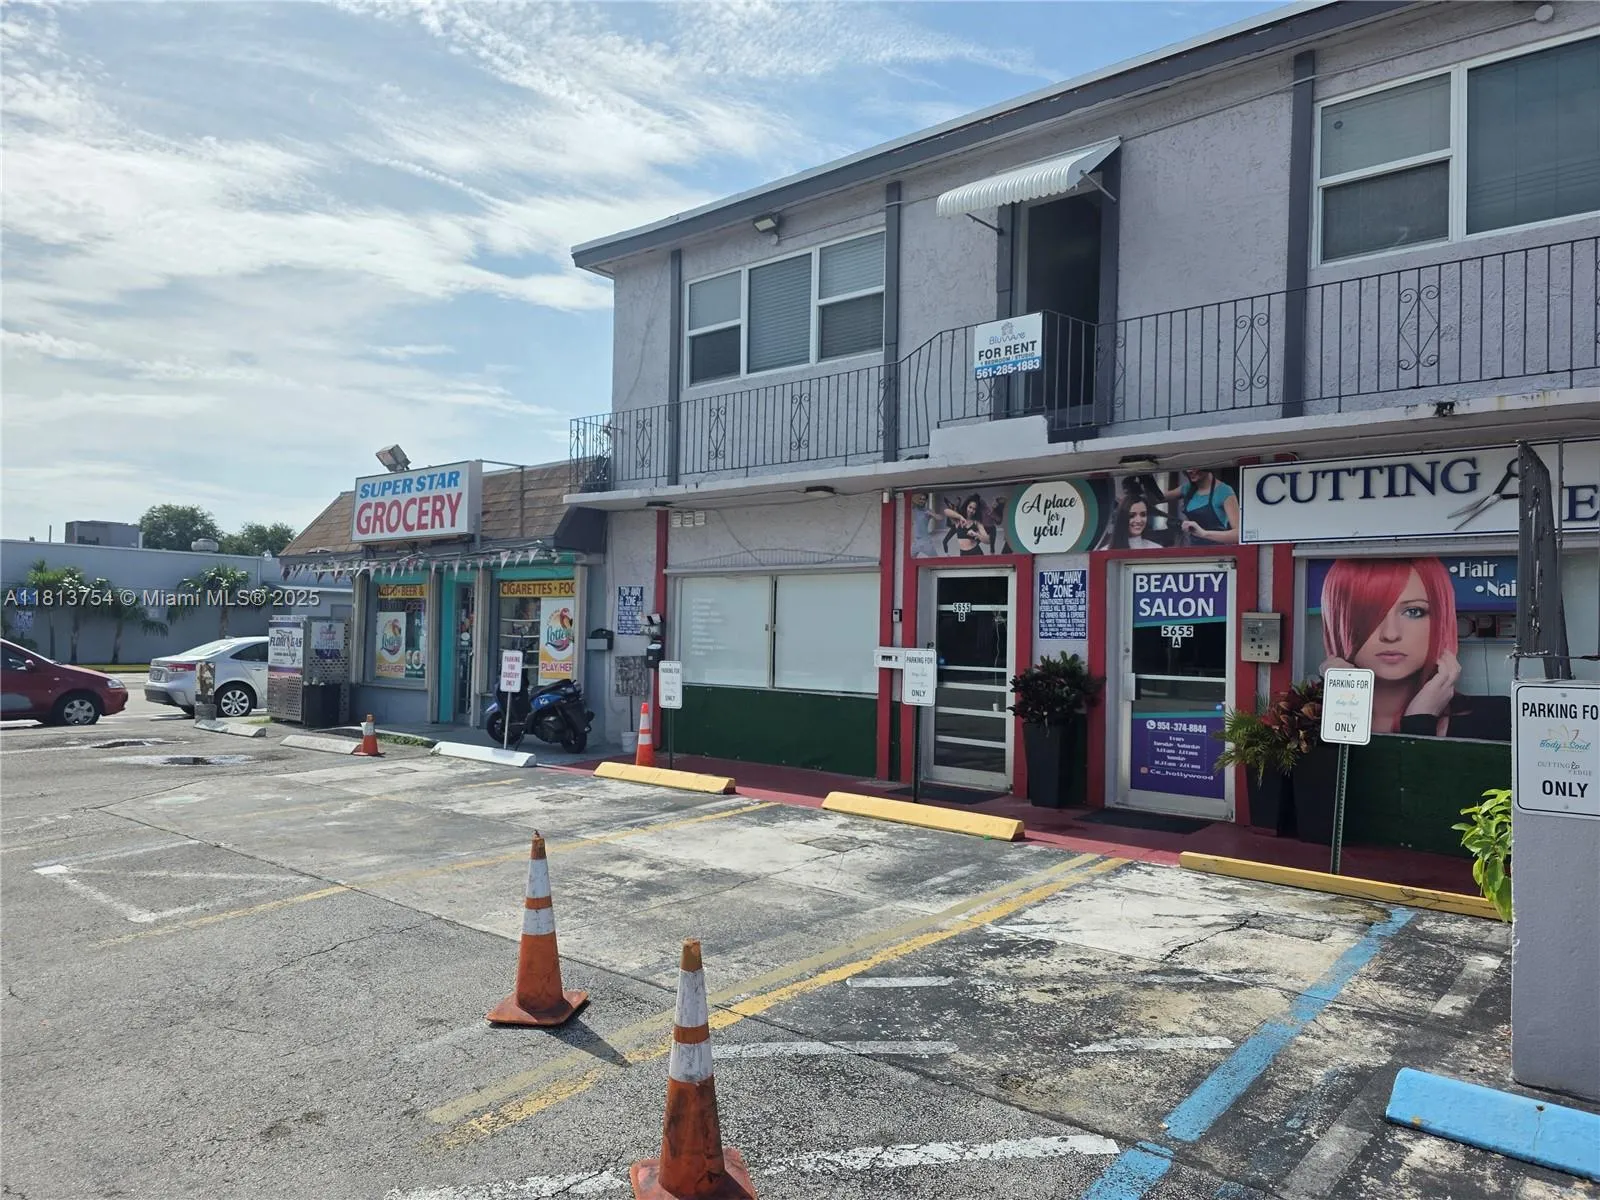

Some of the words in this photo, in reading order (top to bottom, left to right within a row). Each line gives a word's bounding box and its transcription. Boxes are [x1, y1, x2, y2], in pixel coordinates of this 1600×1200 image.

[979, 347, 1001, 361] FOR
[1004, 340, 1037, 356] RENT
[976, 359, 1040, 379] 561-285-1883
[360, 478, 414, 499] SUPER
[415, 470, 461, 492] STAR
[1256, 457, 1480, 506] CUTTING
[1022, 493, 1042, 514] A
[1043, 493, 1076, 516] place
[356, 492, 463, 535] GROCERY
[1047, 510, 1060, 526] for
[1033, 517, 1065, 545] you!
[1460, 561, 1498, 578] Hair
[1043, 570, 1082, 585] TOW-AWAY
[1135, 573, 1224, 593] BEAUTY
[501, 582, 552, 596] CIGARETTES
[1053, 584, 1074, 598] ZONE
[953, 603, 970, 612] 5655
[1138, 597, 1215, 617] SALON
[959, 612, 965, 621] B
[1163, 626, 1193, 636] 5655
[1173, 637, 1181, 647] A
[541, 662, 558, 673] PLAY
[906, 656, 924, 664] PARKING
[925, 656, 934, 664] FOR
[1329, 679, 1355, 689] PARKING
[1356, 680, 1369, 689] FOR
[1522, 702, 1578, 720] PARKING
[1335, 722, 1356, 733] ONLY
[1539, 739, 1562, 753] Body
[1569, 740, 1591, 751] Soul
[1537, 761, 1571, 769] CUTTING
[1542, 779, 1589, 798] ONLY
